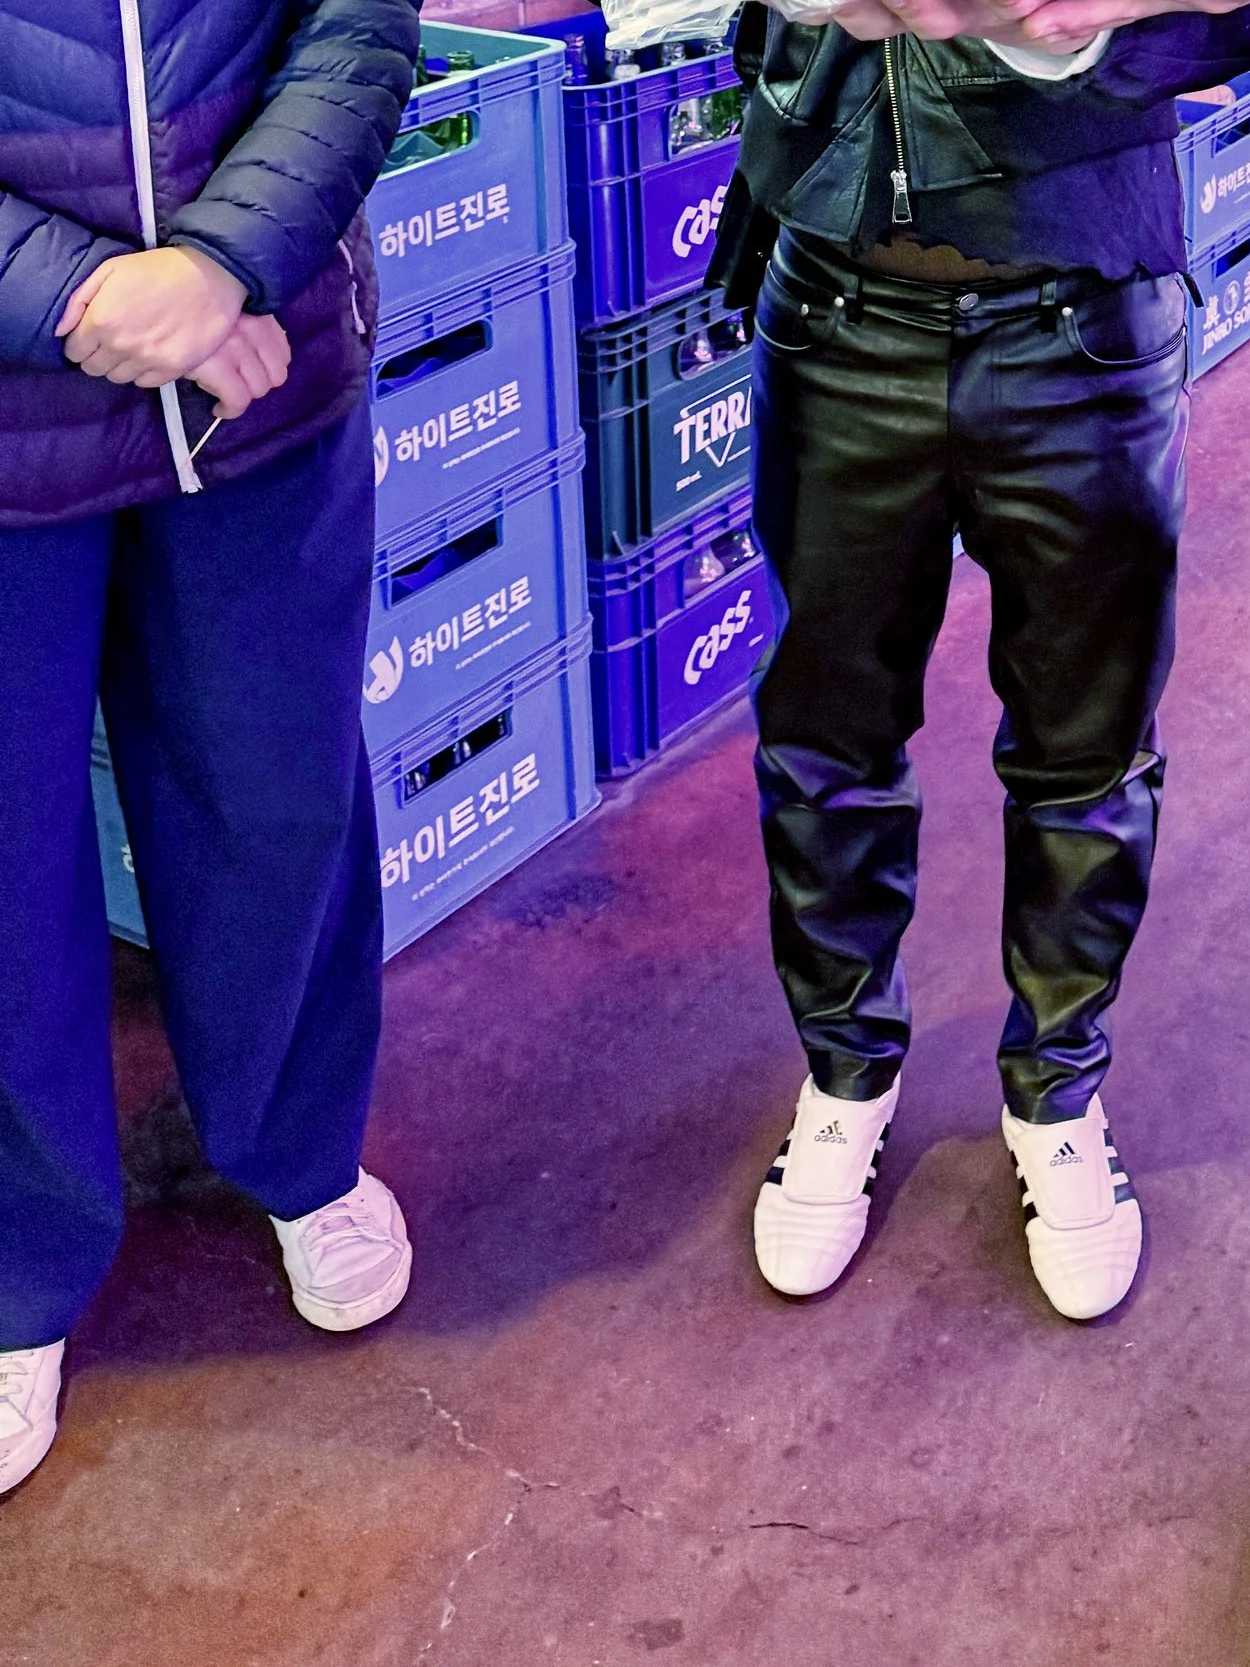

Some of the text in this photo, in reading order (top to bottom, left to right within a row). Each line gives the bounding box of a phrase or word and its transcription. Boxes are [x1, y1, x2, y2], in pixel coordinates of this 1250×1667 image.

[378, 183, 510, 258] 하이트진로
[394, 380, 521, 462] 하이트진로
[408, 575, 532, 668] 하이트진로
[380, 753, 541, 888] 하이트진로
[814, 1133, 848, 1145] adidas
[1049, 1154, 1084, 1167] adidas
